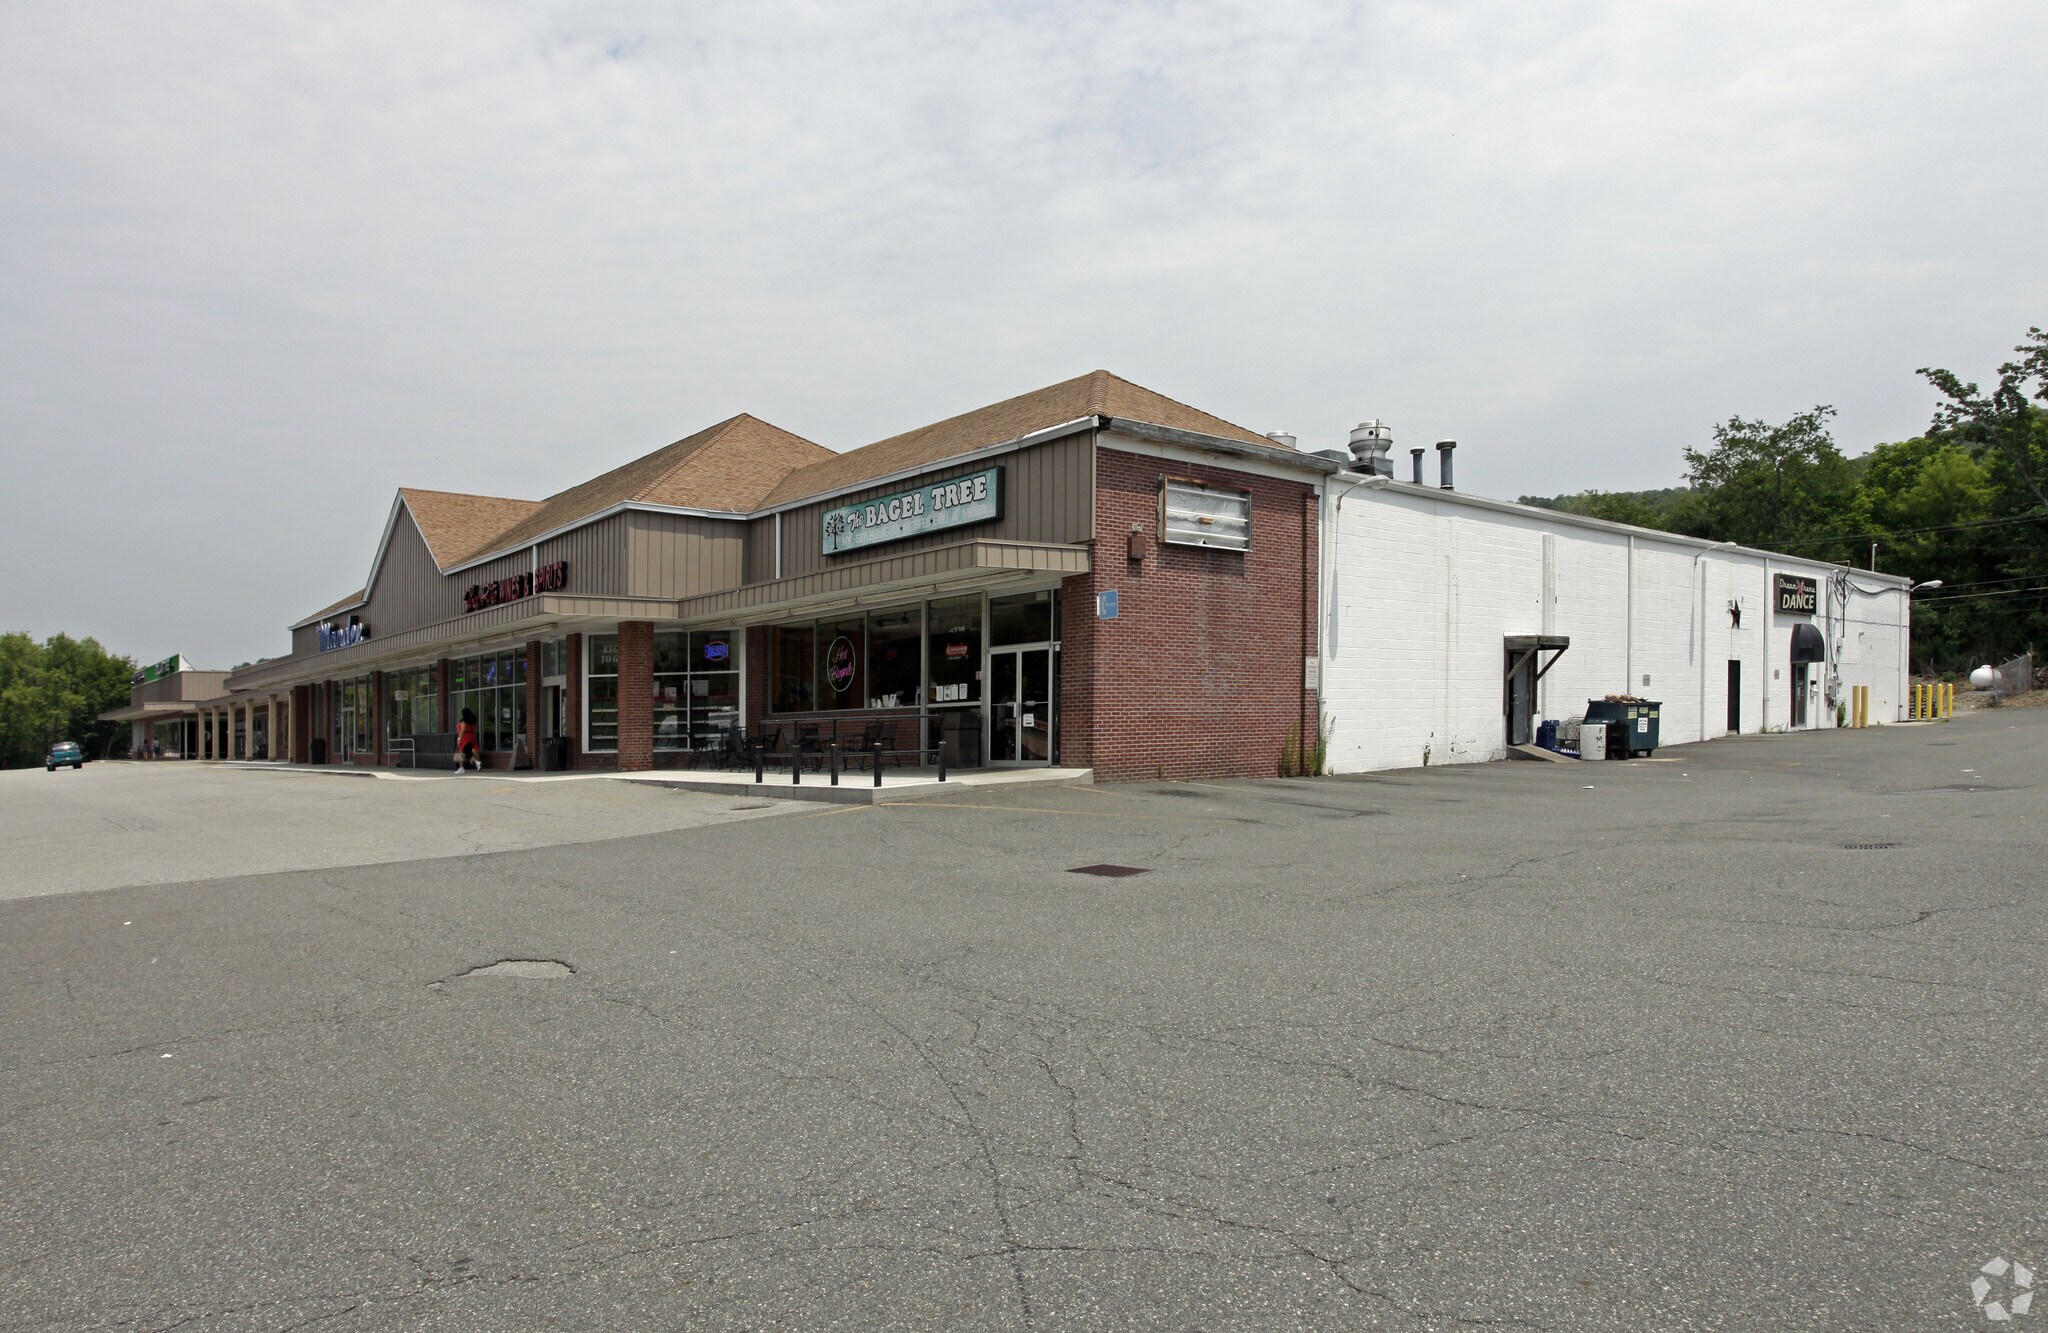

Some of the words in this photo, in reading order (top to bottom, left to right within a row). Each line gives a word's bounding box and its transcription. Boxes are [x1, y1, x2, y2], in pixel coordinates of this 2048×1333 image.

[847, 511, 865, 532] The
[865, 492, 924, 528] BAGEL
[931, 475, 987, 511] TREE
[535, 560, 564, 592] SPIRITS
[1782, 593, 1815, 609] DANCE
[832, 645, 849, 664] Hot
